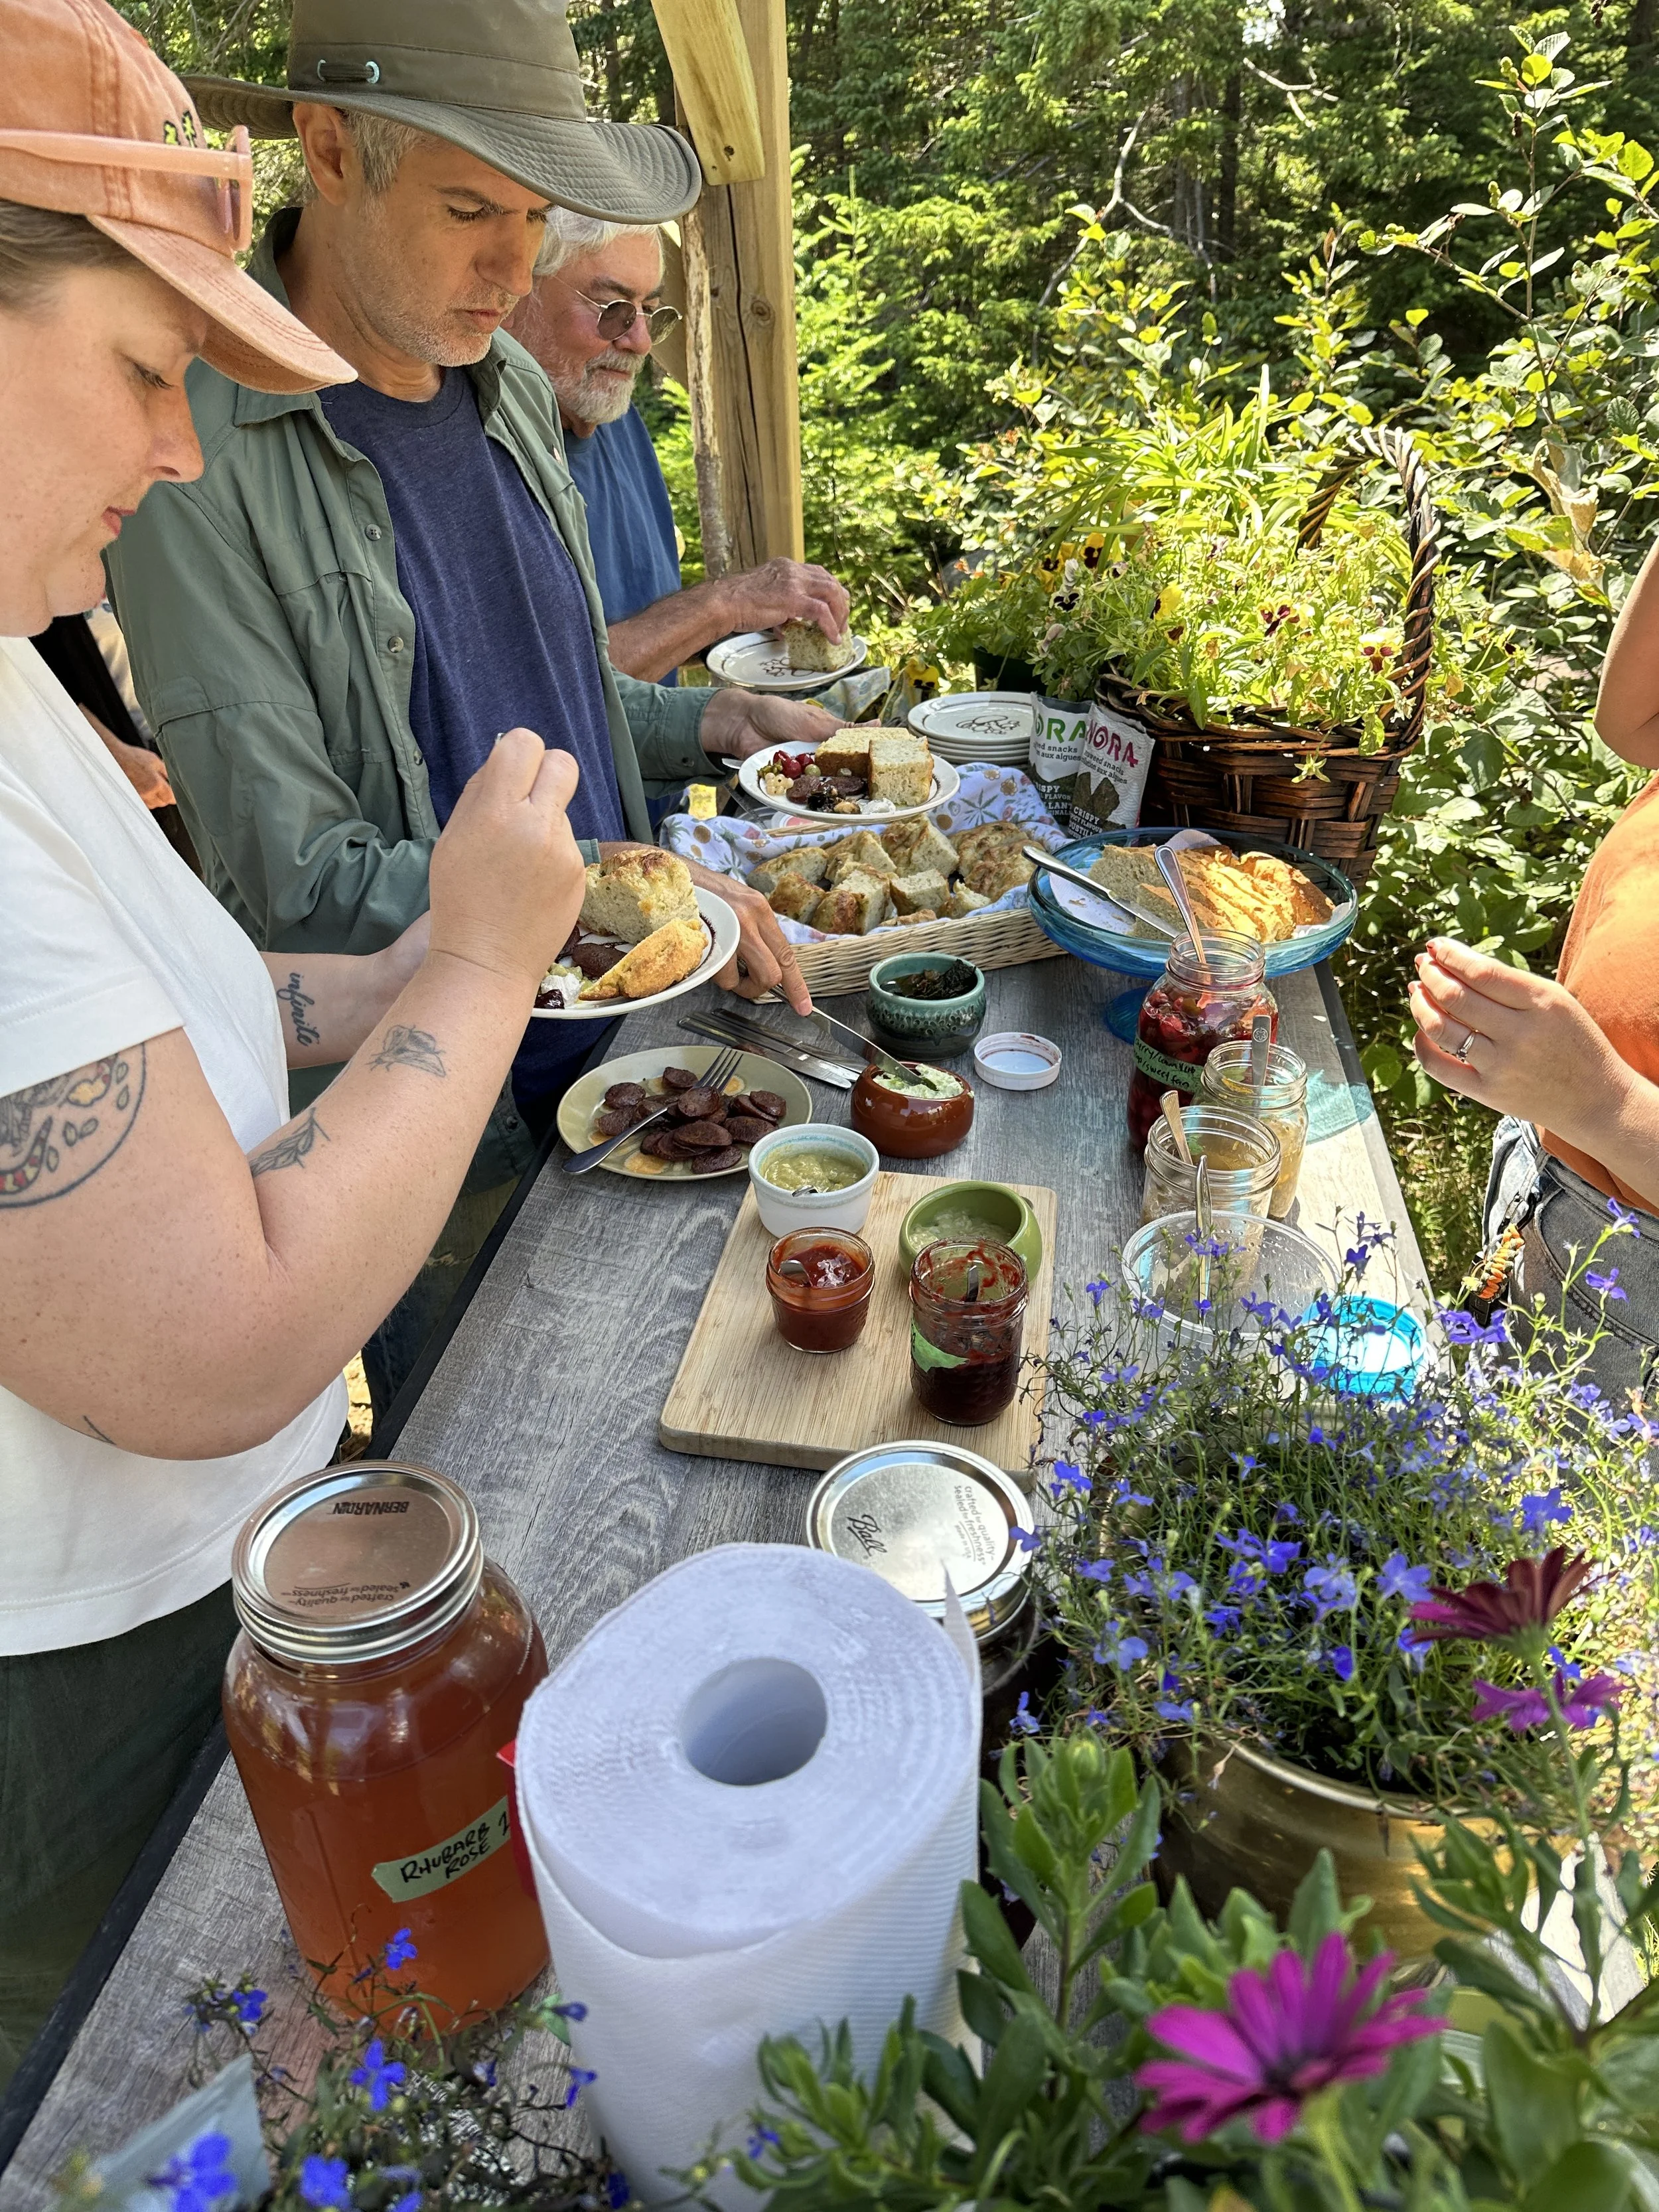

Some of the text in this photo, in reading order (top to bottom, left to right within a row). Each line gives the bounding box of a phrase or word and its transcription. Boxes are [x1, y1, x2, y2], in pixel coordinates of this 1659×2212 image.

[1035, 713, 1086, 743] ORA
[1047, 744, 1078, 753] snacks
[1085, 719, 1139, 768] NORA
[1055, 753, 1081, 762] algues
[1104, 761, 1124, 776] snacks
[1073, 806, 1100, 825] CRISPY
[332, 1501, 410, 1515] BERNARDIN
[954, 1485, 969, 1512] sealed
[965, 1486, 982, 1515] crafted
[846, 1514, 887, 1557] Ball
[292, 1587, 349, 1599] freshness
[351, 1593, 394, 1603] crafted
[360, 1584, 399, 1593] sealed
[400, 1822, 490, 1883] RHUBARB
[445, 1838, 490, 1879] ROSE
